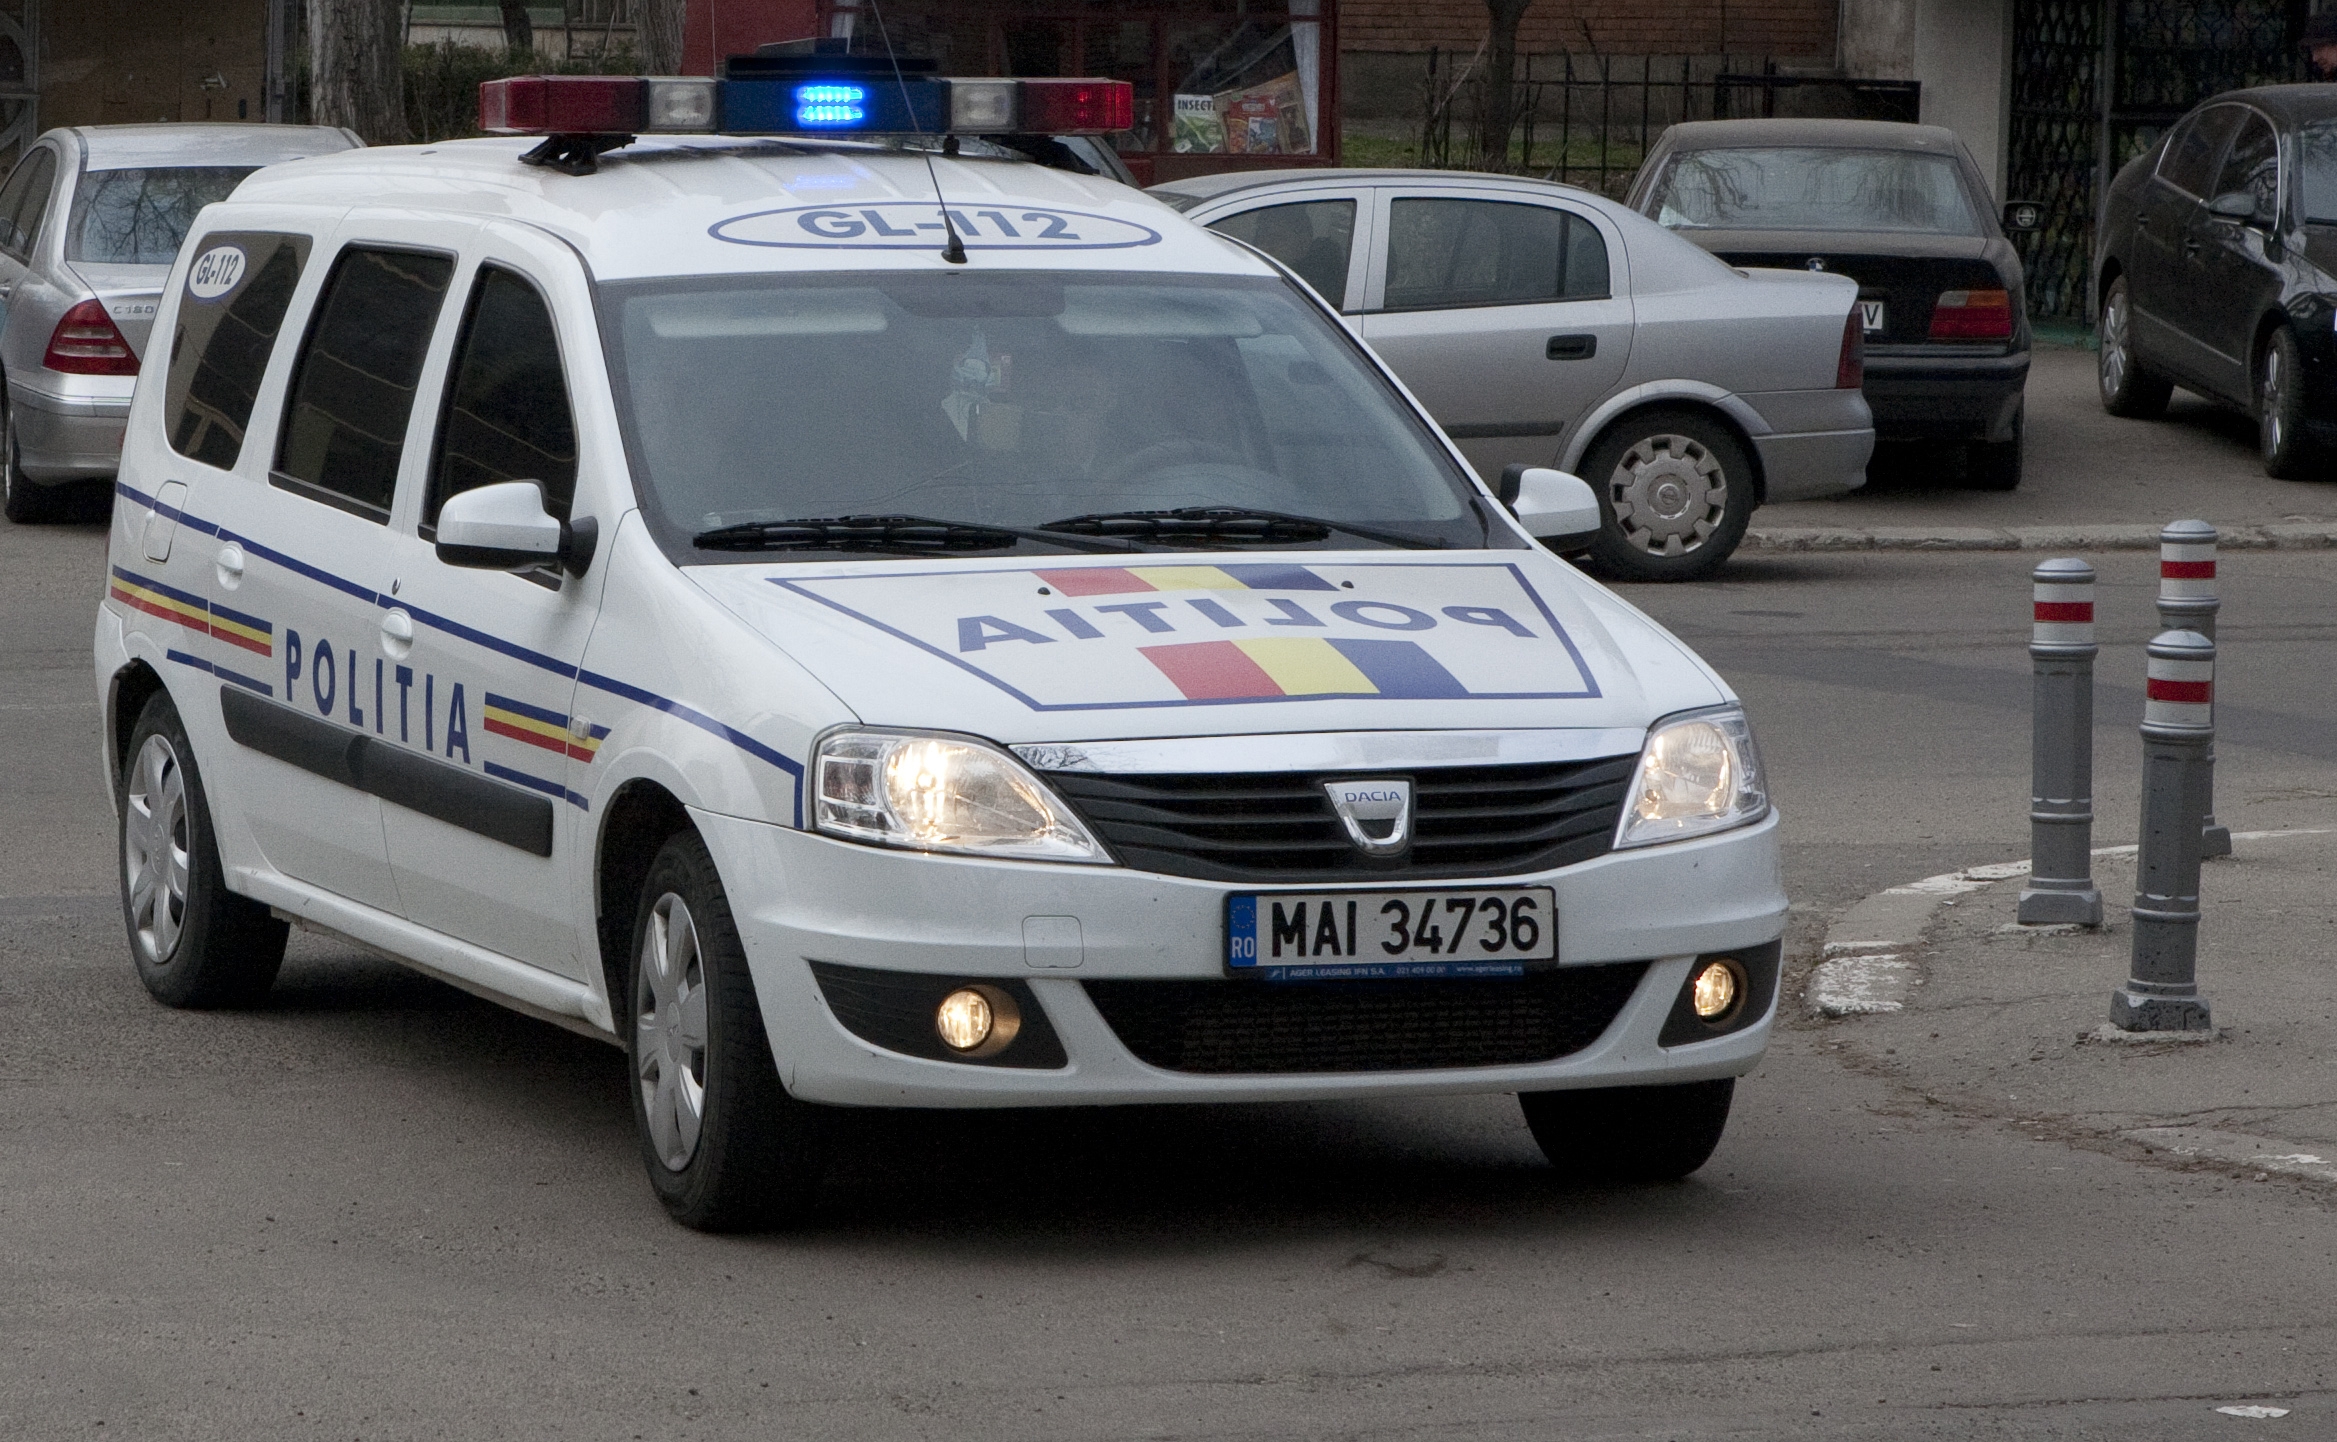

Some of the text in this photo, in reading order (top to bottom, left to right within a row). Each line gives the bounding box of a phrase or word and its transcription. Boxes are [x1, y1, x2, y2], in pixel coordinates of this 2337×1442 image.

[1178, 99, 1216, 111] INSECT
[797, 210, 1081, 240] GL-112
[196, 253, 239, 285] GL-112
[126, 306, 154, 314] 180
[286, 628, 471, 764] POLITIA
[1345, 791, 1401, 802] DACIA
[1271, 896, 1540, 957] MAI 34736
[1231, 937, 1255, 958] RO
[1290, 969, 1314, 977] AGER
[1315, 968, 1352, 977] LEASING
